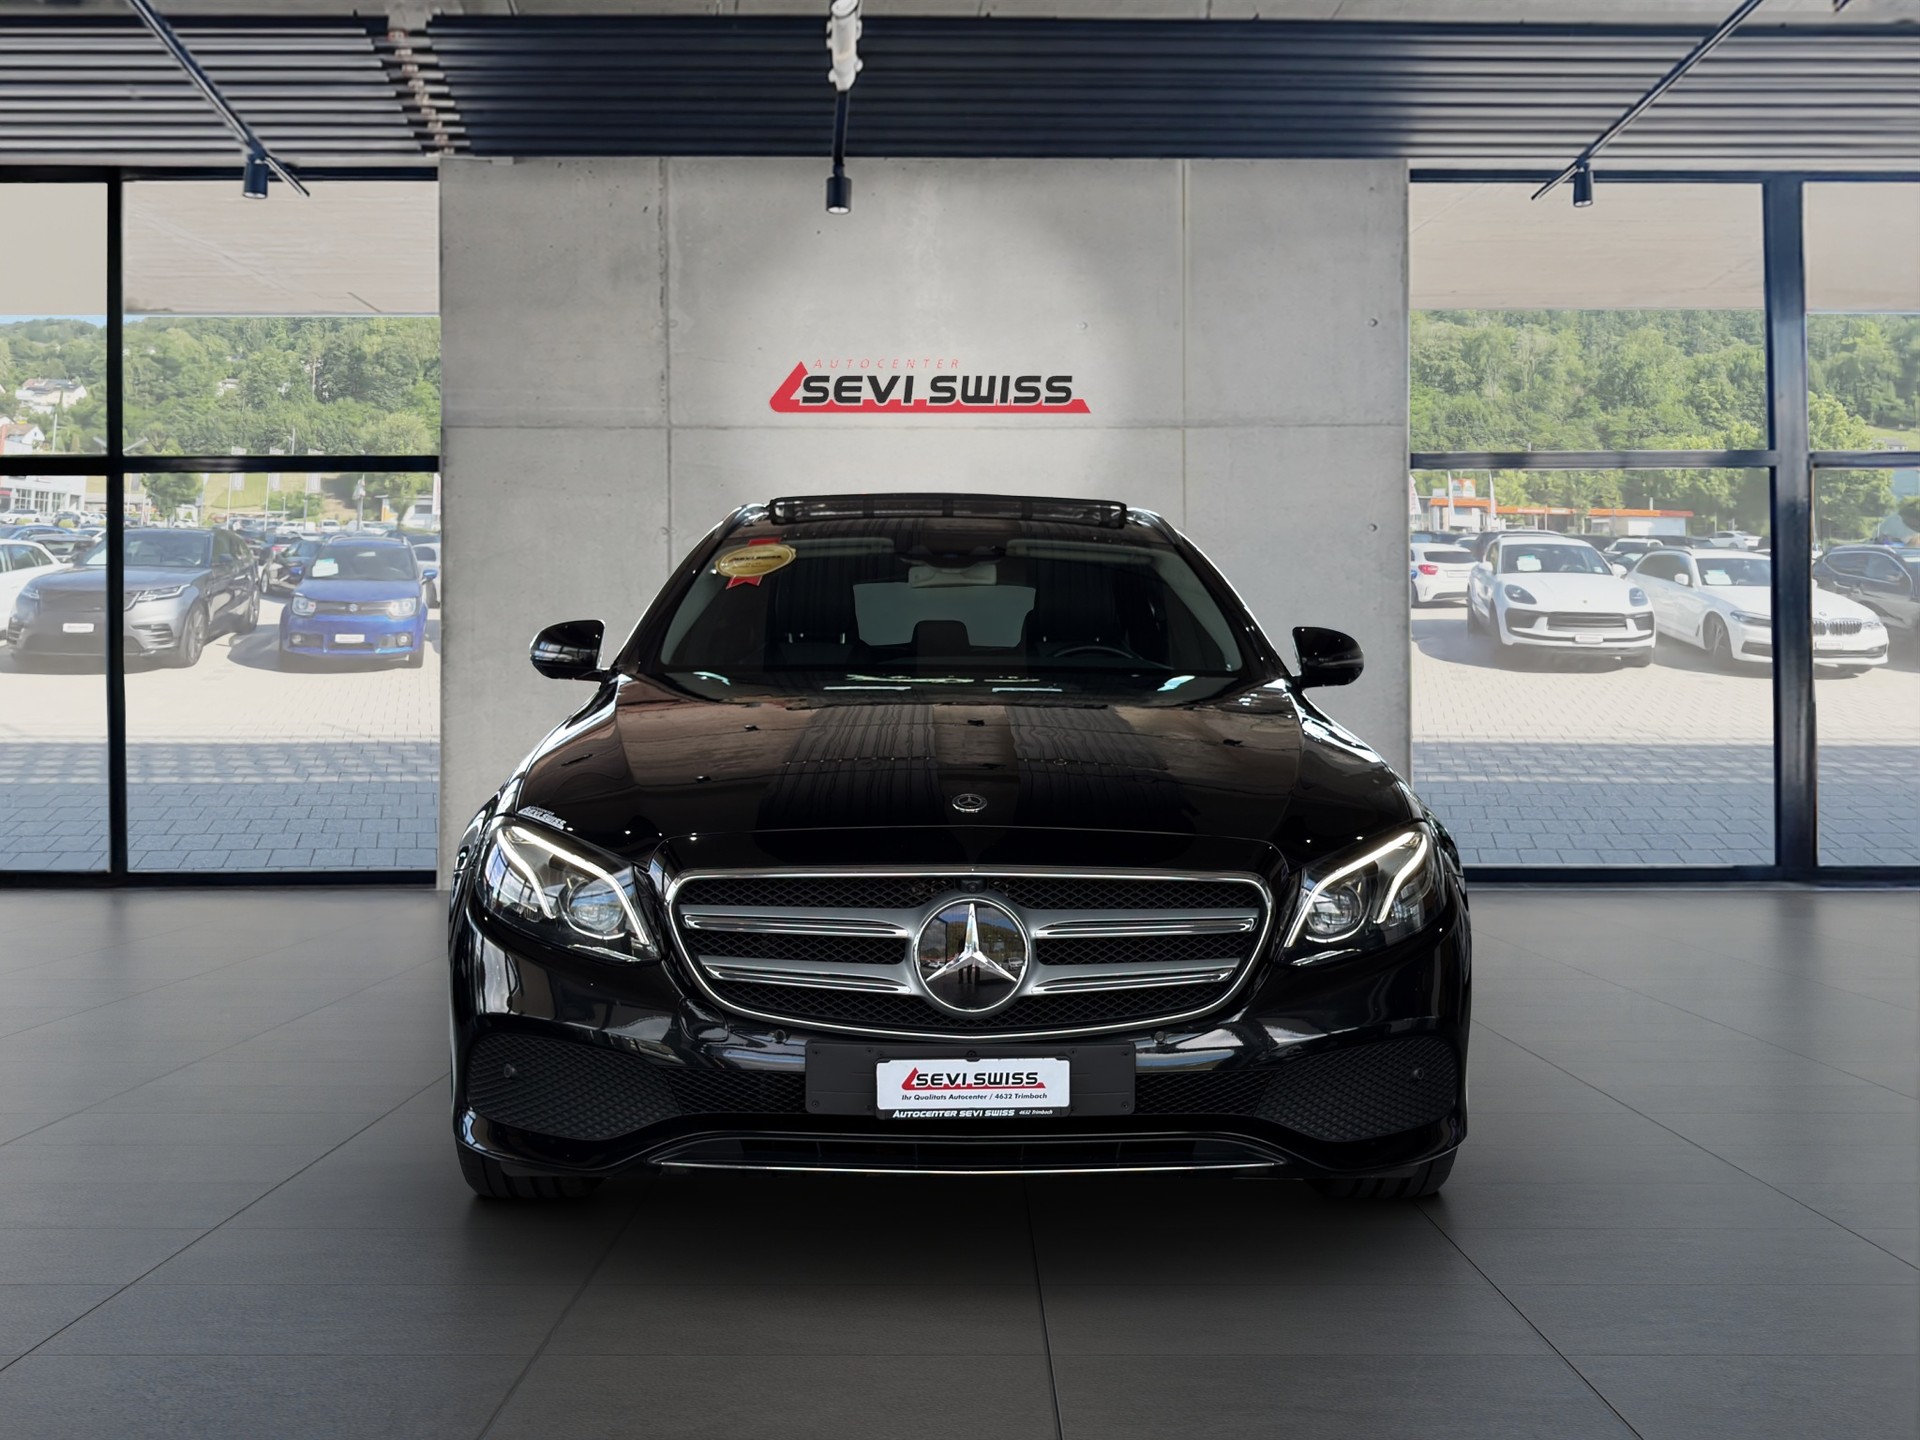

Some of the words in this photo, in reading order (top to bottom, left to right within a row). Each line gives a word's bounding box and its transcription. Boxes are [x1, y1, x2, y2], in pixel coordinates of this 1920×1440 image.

[813, 358, 959, 369] AUTOCENTER
[801, 375, 914, 404] SEVI
[929, 375, 1073, 404] SWISS
[915, 1073, 967, 1086] SEVI
[973, 1072, 1038, 1085] SWISS
[959, 1109, 984, 1117] SEVI
[984, 1109, 1015, 1117] SWISS
